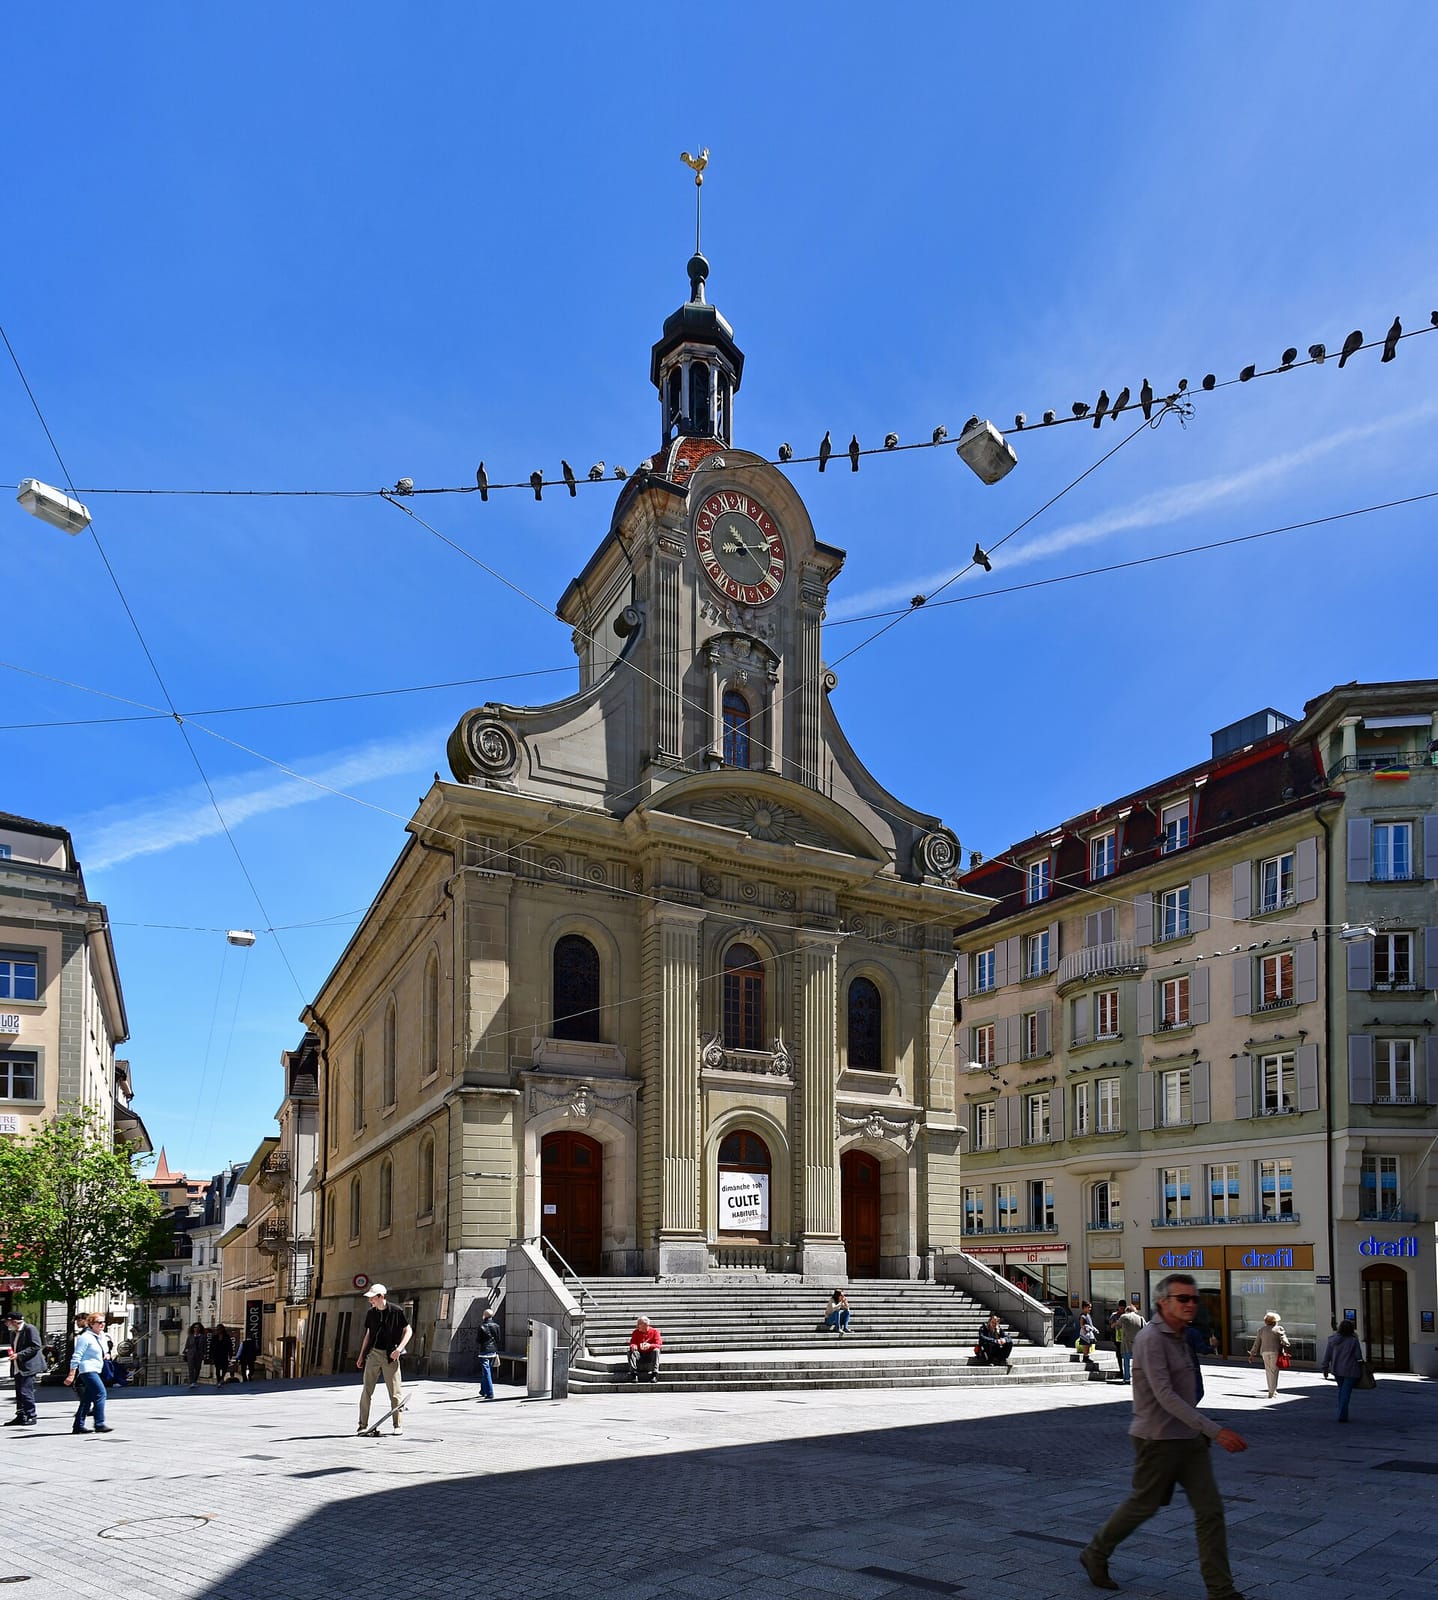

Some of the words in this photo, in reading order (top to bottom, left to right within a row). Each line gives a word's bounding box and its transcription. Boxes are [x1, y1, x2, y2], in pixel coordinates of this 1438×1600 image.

[722, 1184, 750, 1192] dimanche
[728, 1194, 760, 1208] CULTE
[732, 1210, 758, 1218] HABITUEL
[1358, 1235, 1418, 1257] drafil
[1027, 1252, 1038, 1263] ici
[1159, 1249, 1204, 1268] drafil
[1241, 1248, 1294, 1268] drafil
[249, 1306, 260, 1344] ANOR
